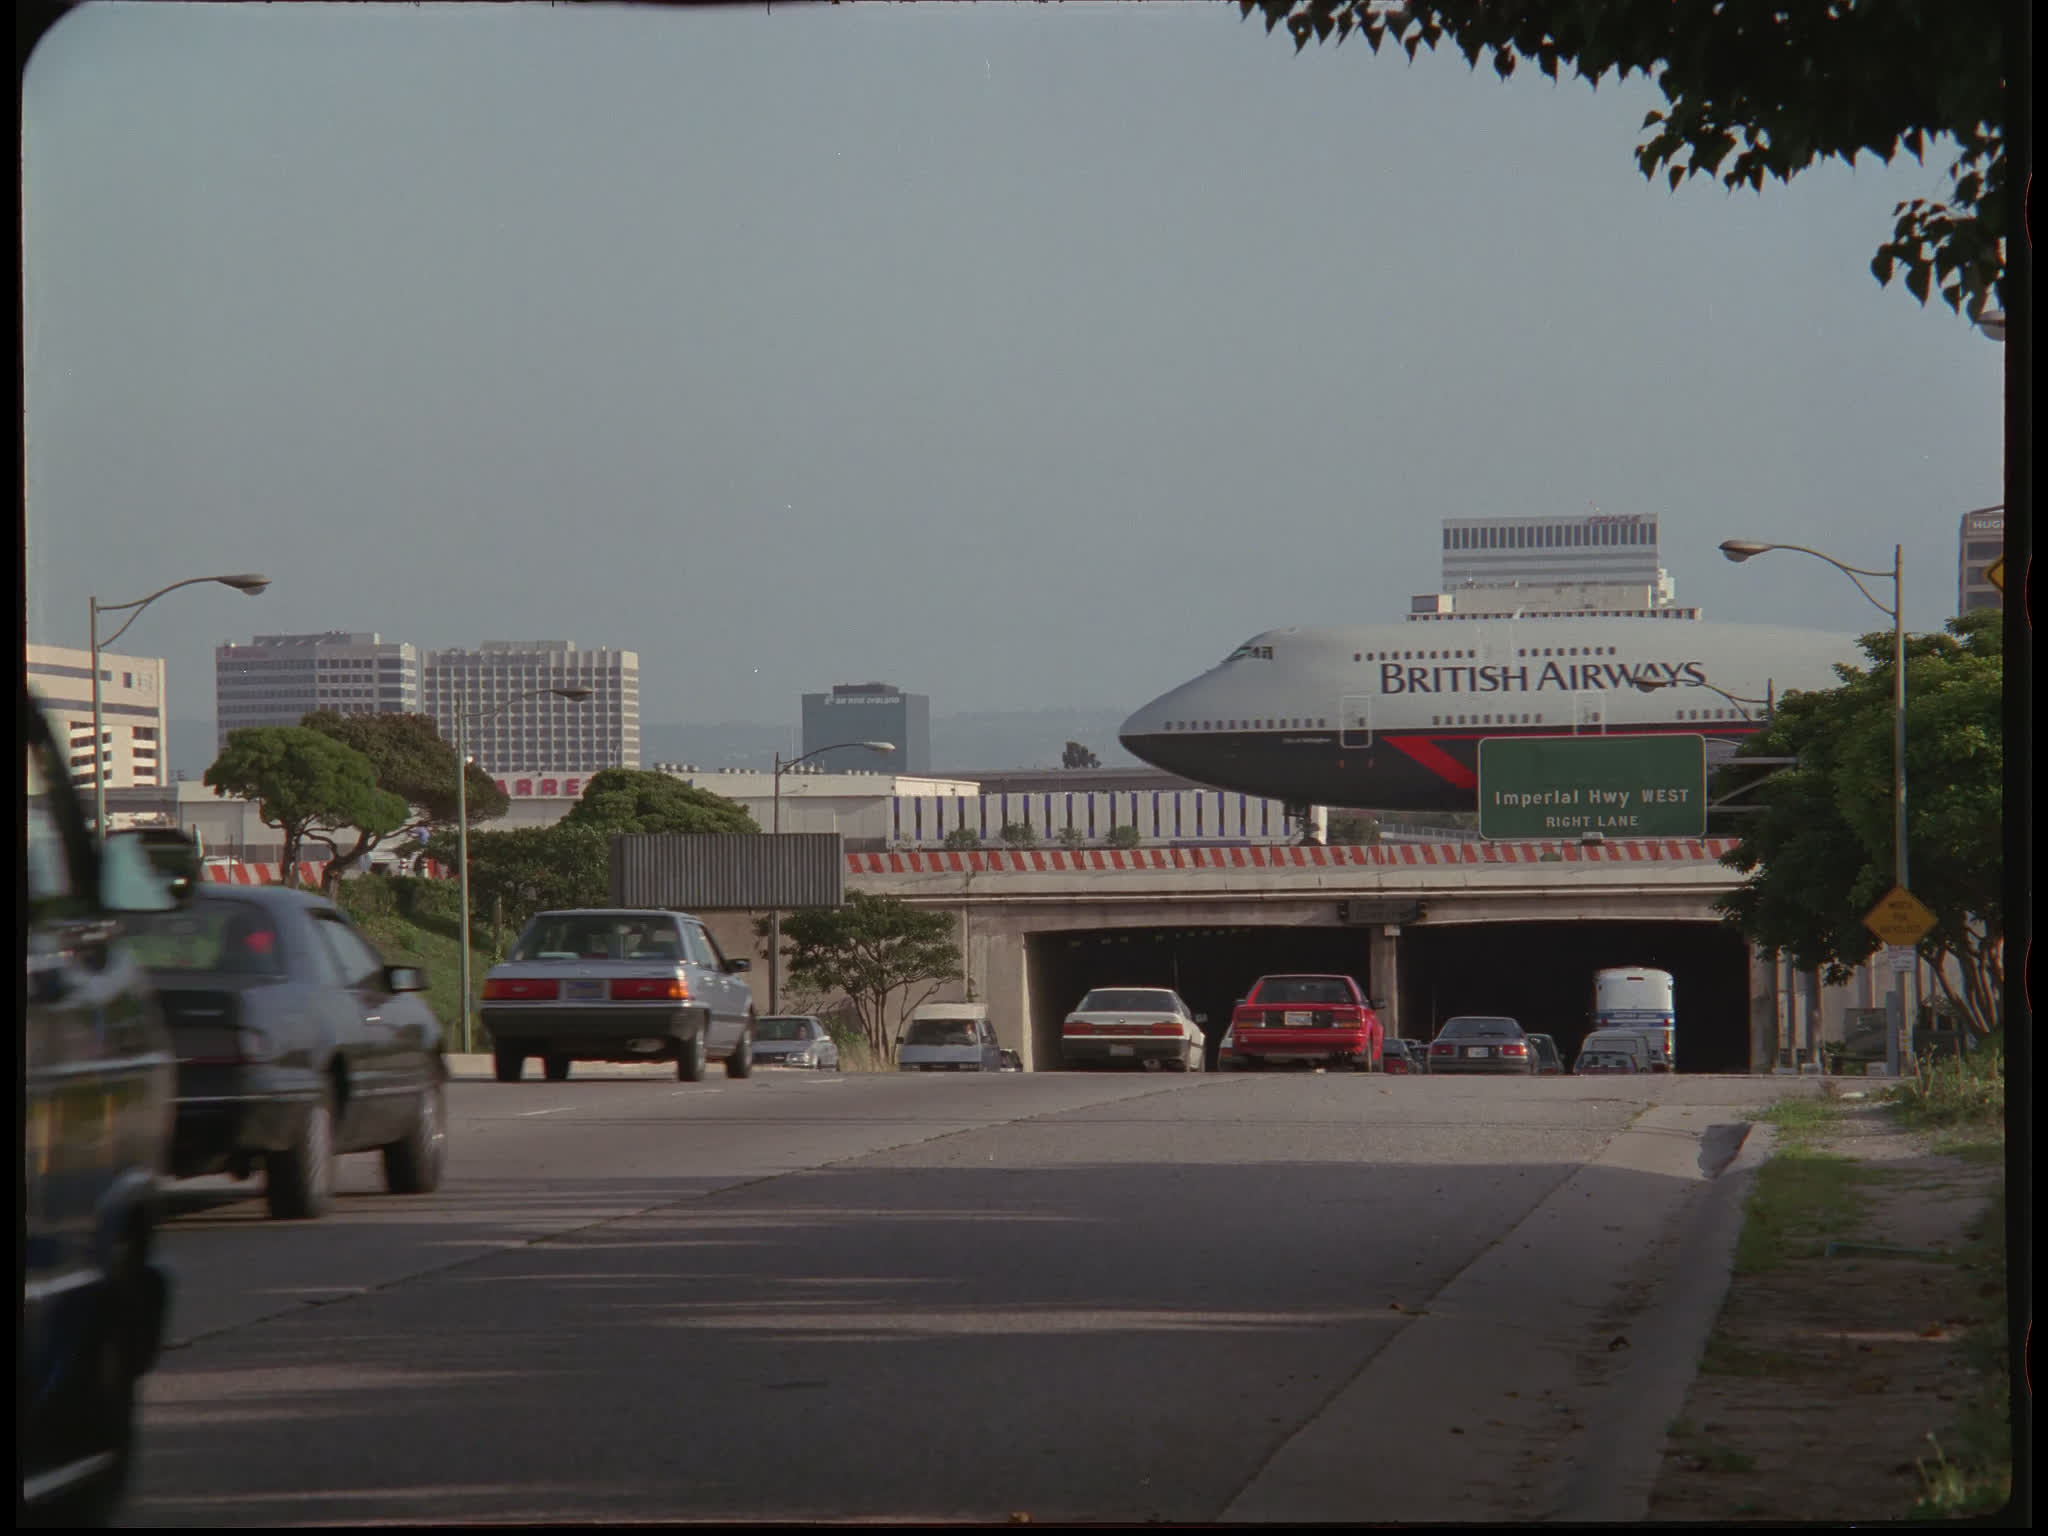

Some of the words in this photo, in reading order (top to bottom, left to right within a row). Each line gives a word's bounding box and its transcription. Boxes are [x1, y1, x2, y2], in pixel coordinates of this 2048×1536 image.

[1380, 662, 1528, 694] BRITISH
[1537, 661, 1705, 692] AIRWAYS
[1495, 790, 1579, 808] Imperial
[1589, 789, 1630, 809] Hwy
[1642, 788, 1689, 802] WEST
[1545, 815, 1591, 828] RIGHT
[1598, 814, 1639, 827] LANE
